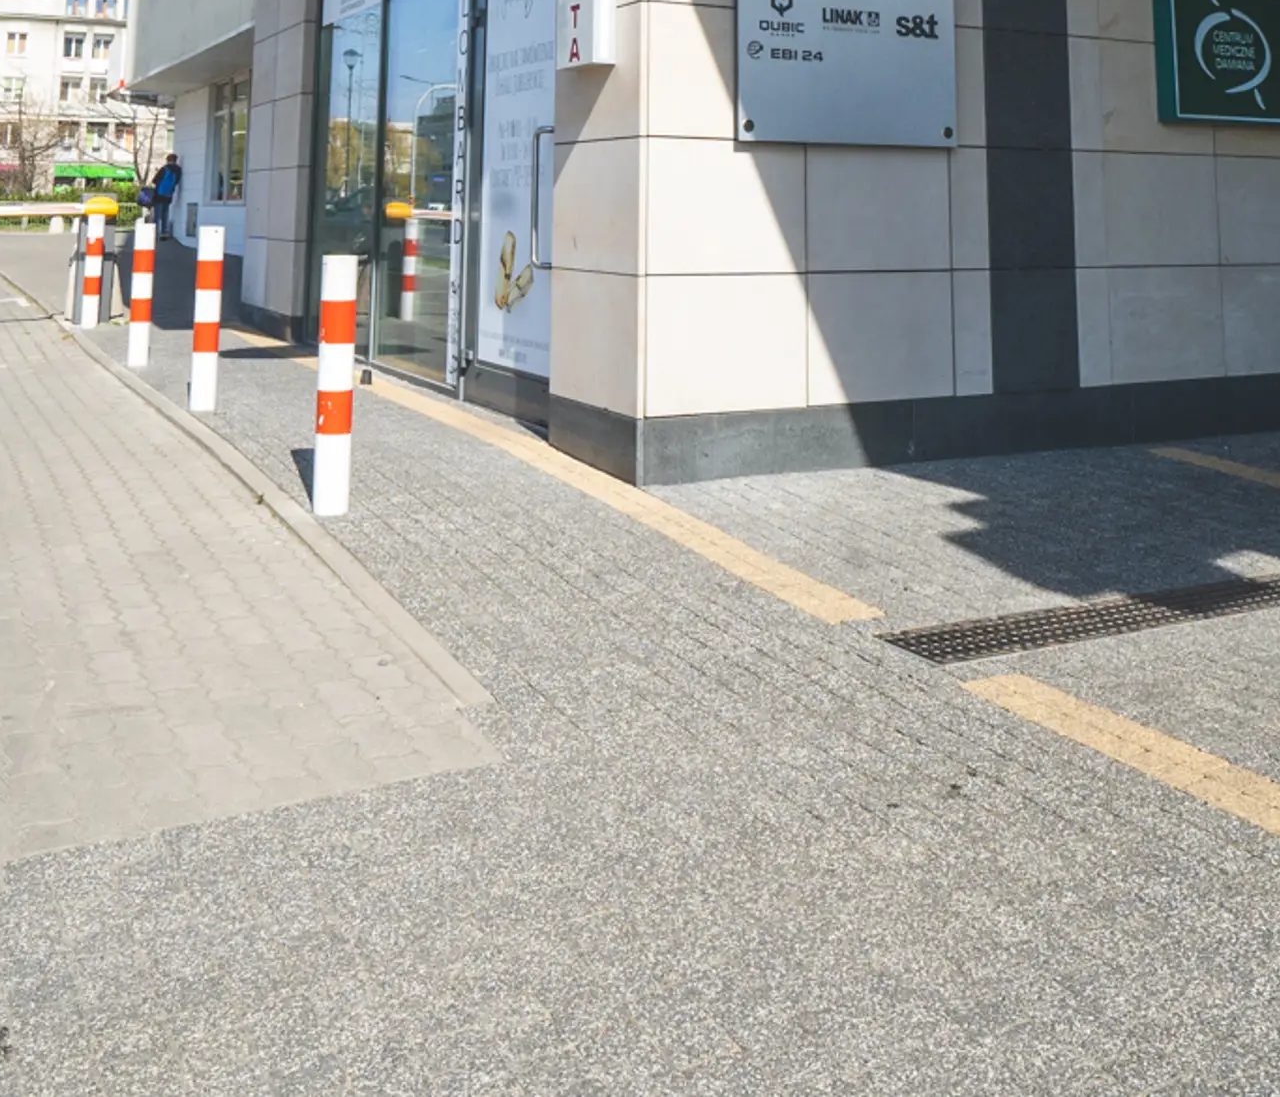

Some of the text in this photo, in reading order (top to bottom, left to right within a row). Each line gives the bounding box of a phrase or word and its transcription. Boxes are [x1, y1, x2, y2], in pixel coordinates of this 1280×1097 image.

[822, 6, 863, 26] LINAK
[758, 19, 805, 34] QUBIC
[895, 13, 939, 40] s&t
[770, 47, 824, 63] EBI 24
